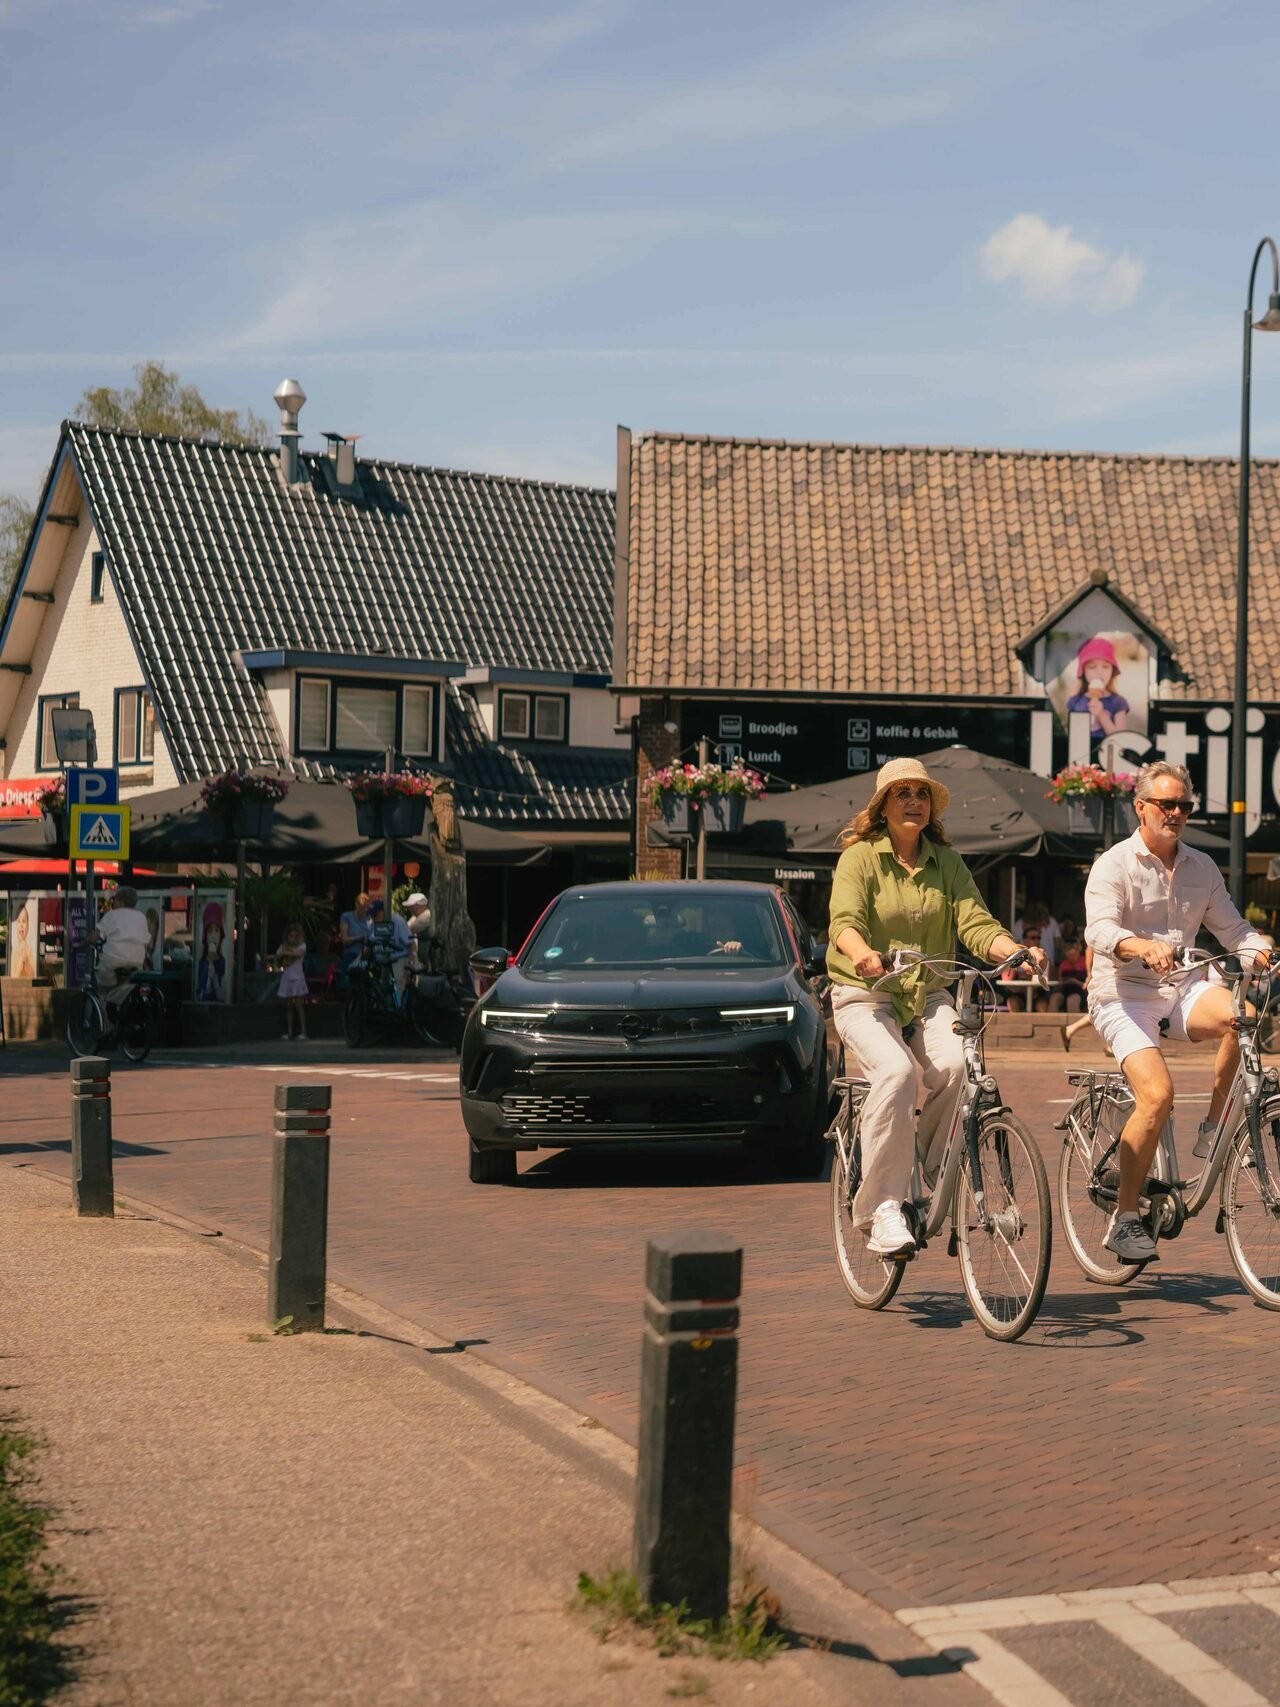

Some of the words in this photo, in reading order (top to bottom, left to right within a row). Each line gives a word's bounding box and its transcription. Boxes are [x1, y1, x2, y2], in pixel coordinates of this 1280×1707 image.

[749, 722, 798, 737] Broodjes
[876, 725, 910, 738] Koffie
[912, 727, 920, 738] &
[923, 726, 959, 739] Gebak
[748, 750, 781, 762] Lunch
[79, 774, 107, 804] P
[775, 869, 815, 879] IJssalon
